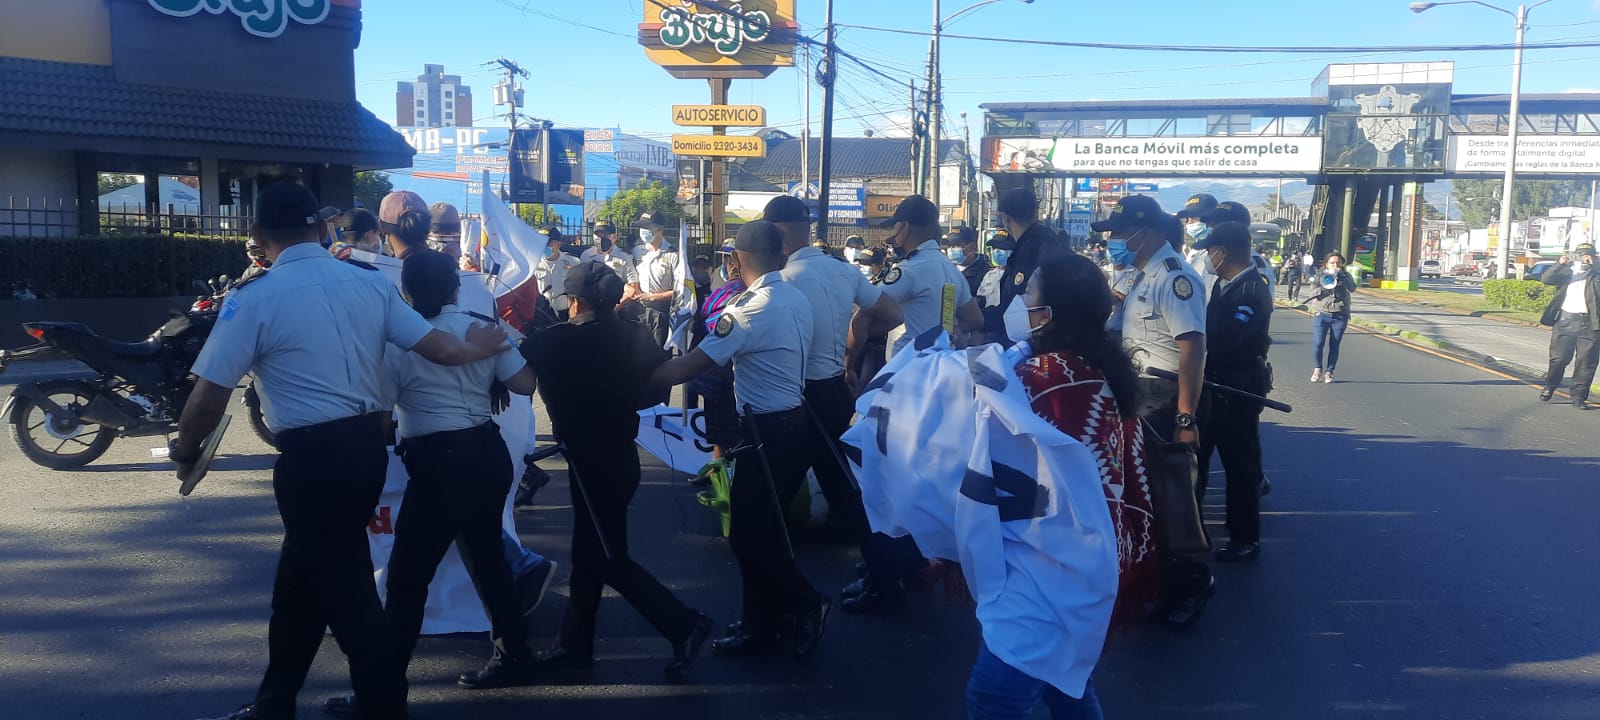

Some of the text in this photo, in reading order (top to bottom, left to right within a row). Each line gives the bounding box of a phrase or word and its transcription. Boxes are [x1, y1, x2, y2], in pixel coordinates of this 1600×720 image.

[660, 3, 771, 54] Brujo
[676, 109, 758, 121] AUTOSERVICIO
[396, 128, 490, 154] MB-PC
[674, 140, 758, 151] Domicilio 2320-3434
[1468, 139, 1495, 147] Desde
[1075, 142, 1299, 156] La Banca Móvil más completa
[1467, 149, 1478, 157] de
[1480, 149, 1506, 157] forma
[1558, 149, 1586, 159] digital
[1073, 159, 1095, 168] para
[1097, 159, 1116, 168] que
[1135, 159, 1169, 168] tengas
[1171, 159, 1190, 168] que
[1193, 157, 1216, 166] salir
[1219, 157, 1231, 166] de
[1525, 161, 1548, 169] reglas
